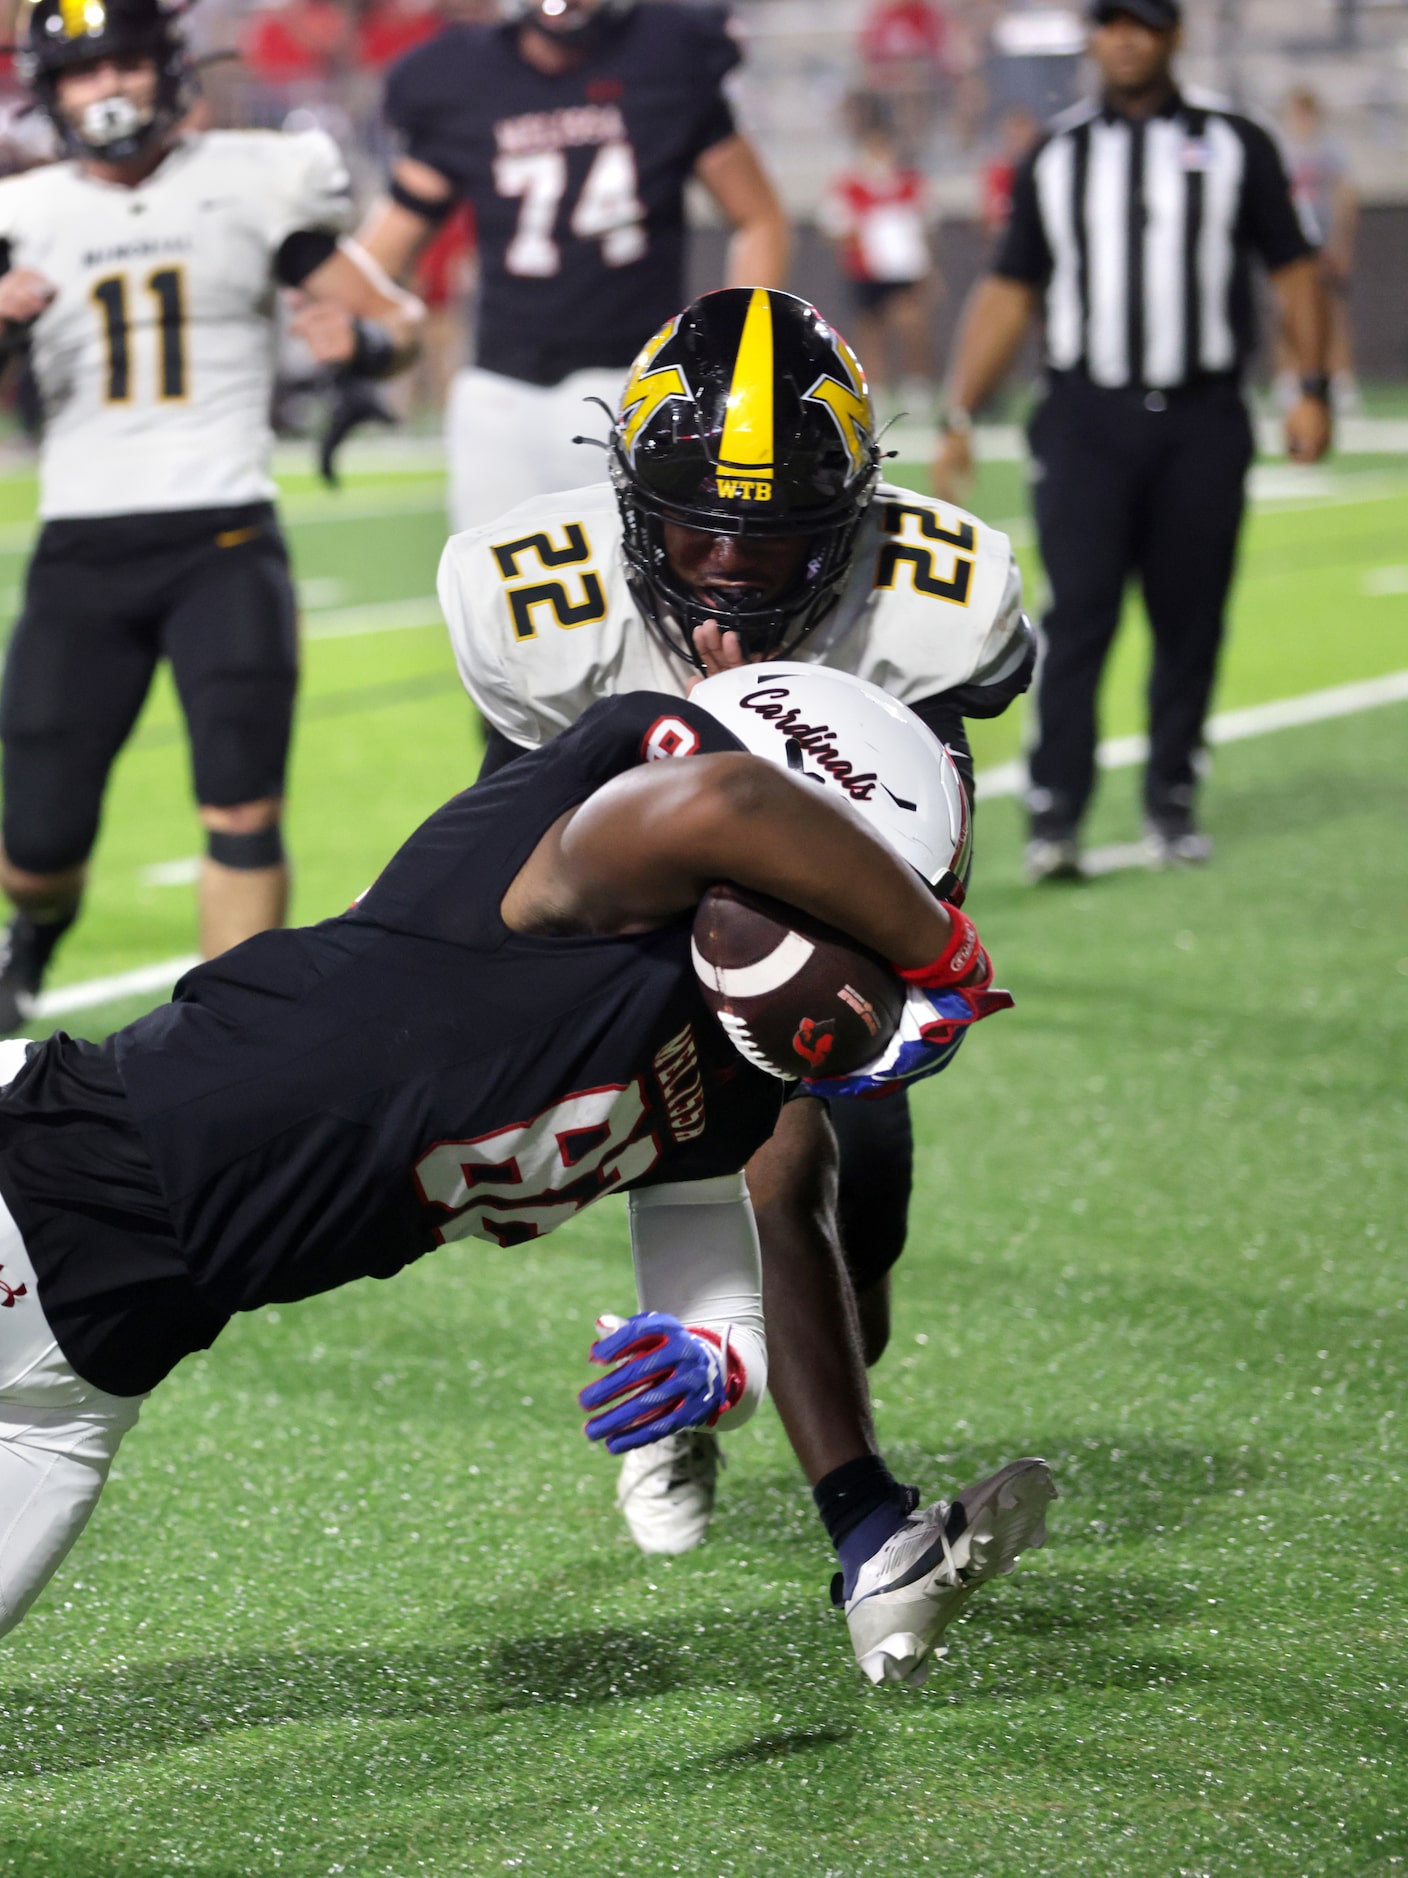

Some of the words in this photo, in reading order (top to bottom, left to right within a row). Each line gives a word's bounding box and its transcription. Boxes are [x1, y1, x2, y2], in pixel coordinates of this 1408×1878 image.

[490, 142, 649, 279] 74
[88, 264, 190, 407] 11
[716, 477, 773, 502] WTB
[489, 520, 610, 643] 22
[873, 501, 978, 609] 22
[739, 688, 878, 802] Cardinals
[654, 1022, 707, 1143] MELISSA
